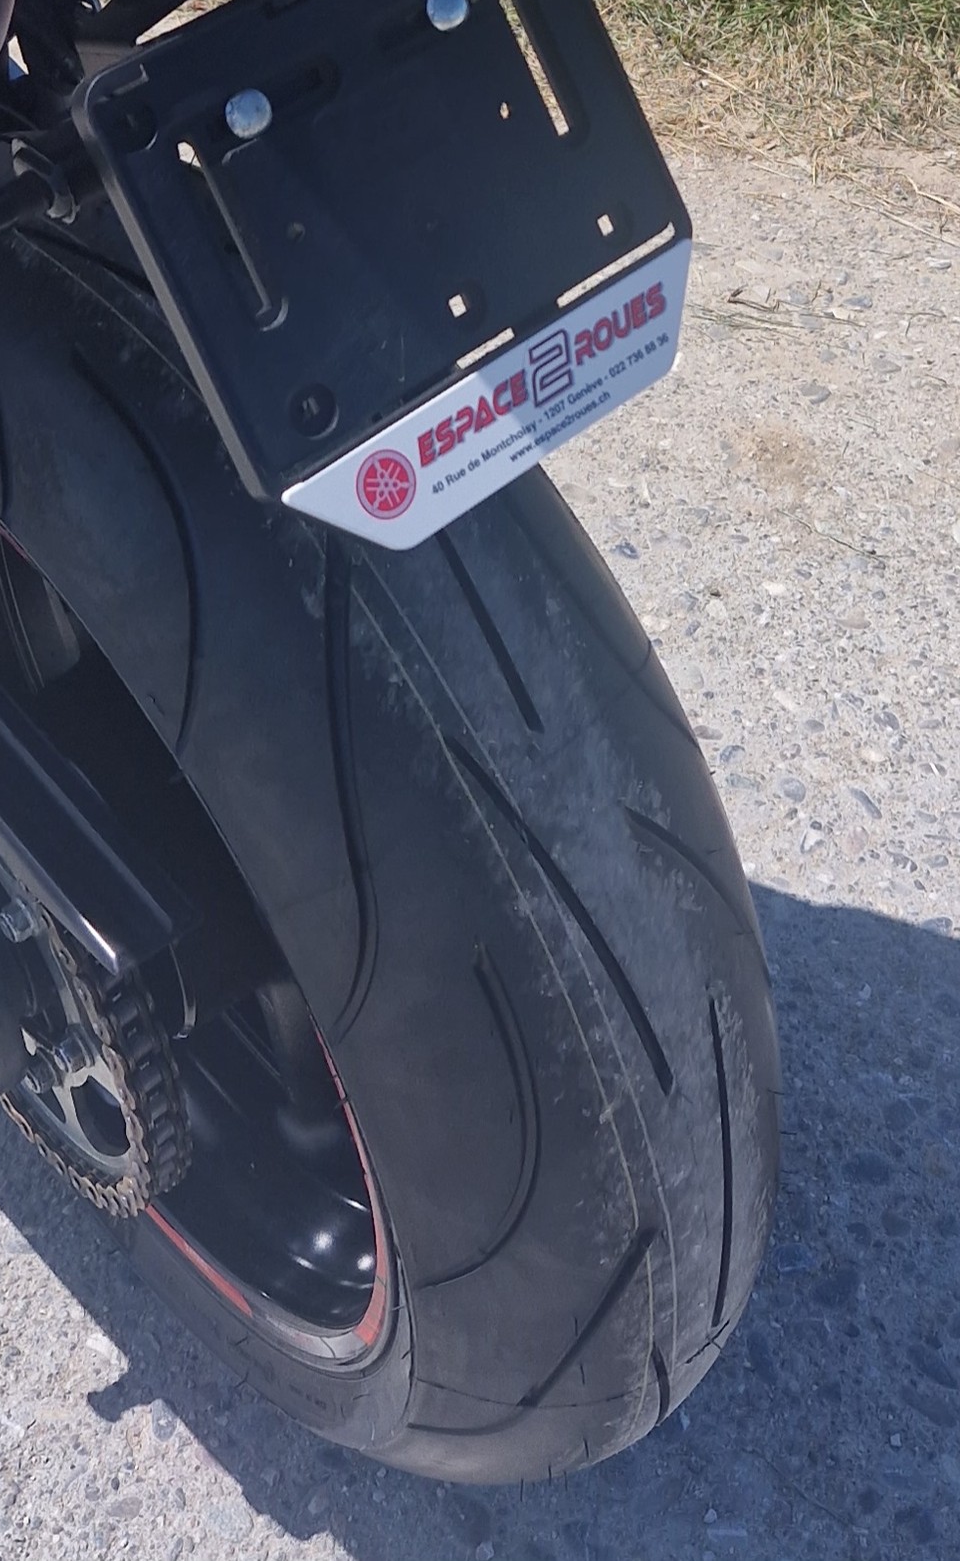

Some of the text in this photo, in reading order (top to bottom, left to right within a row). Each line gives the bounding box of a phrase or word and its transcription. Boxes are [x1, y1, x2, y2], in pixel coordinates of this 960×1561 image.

[417, 281, 667, 468] ESPACE 2 ROUES
[432, 481, 445, 494] 40
[445, 468, 466, 486] Rue
[467, 458, 481, 472] de
[481, 420, 538, 462] Montchoisy
[544, 400, 566, 420] 1207
[567, 376, 604, 405] Genève
[609, 360, 626, 378] 022
[626, 348, 644, 366] 736
[509, 390, 611, 463] www.espace2roues.ch
